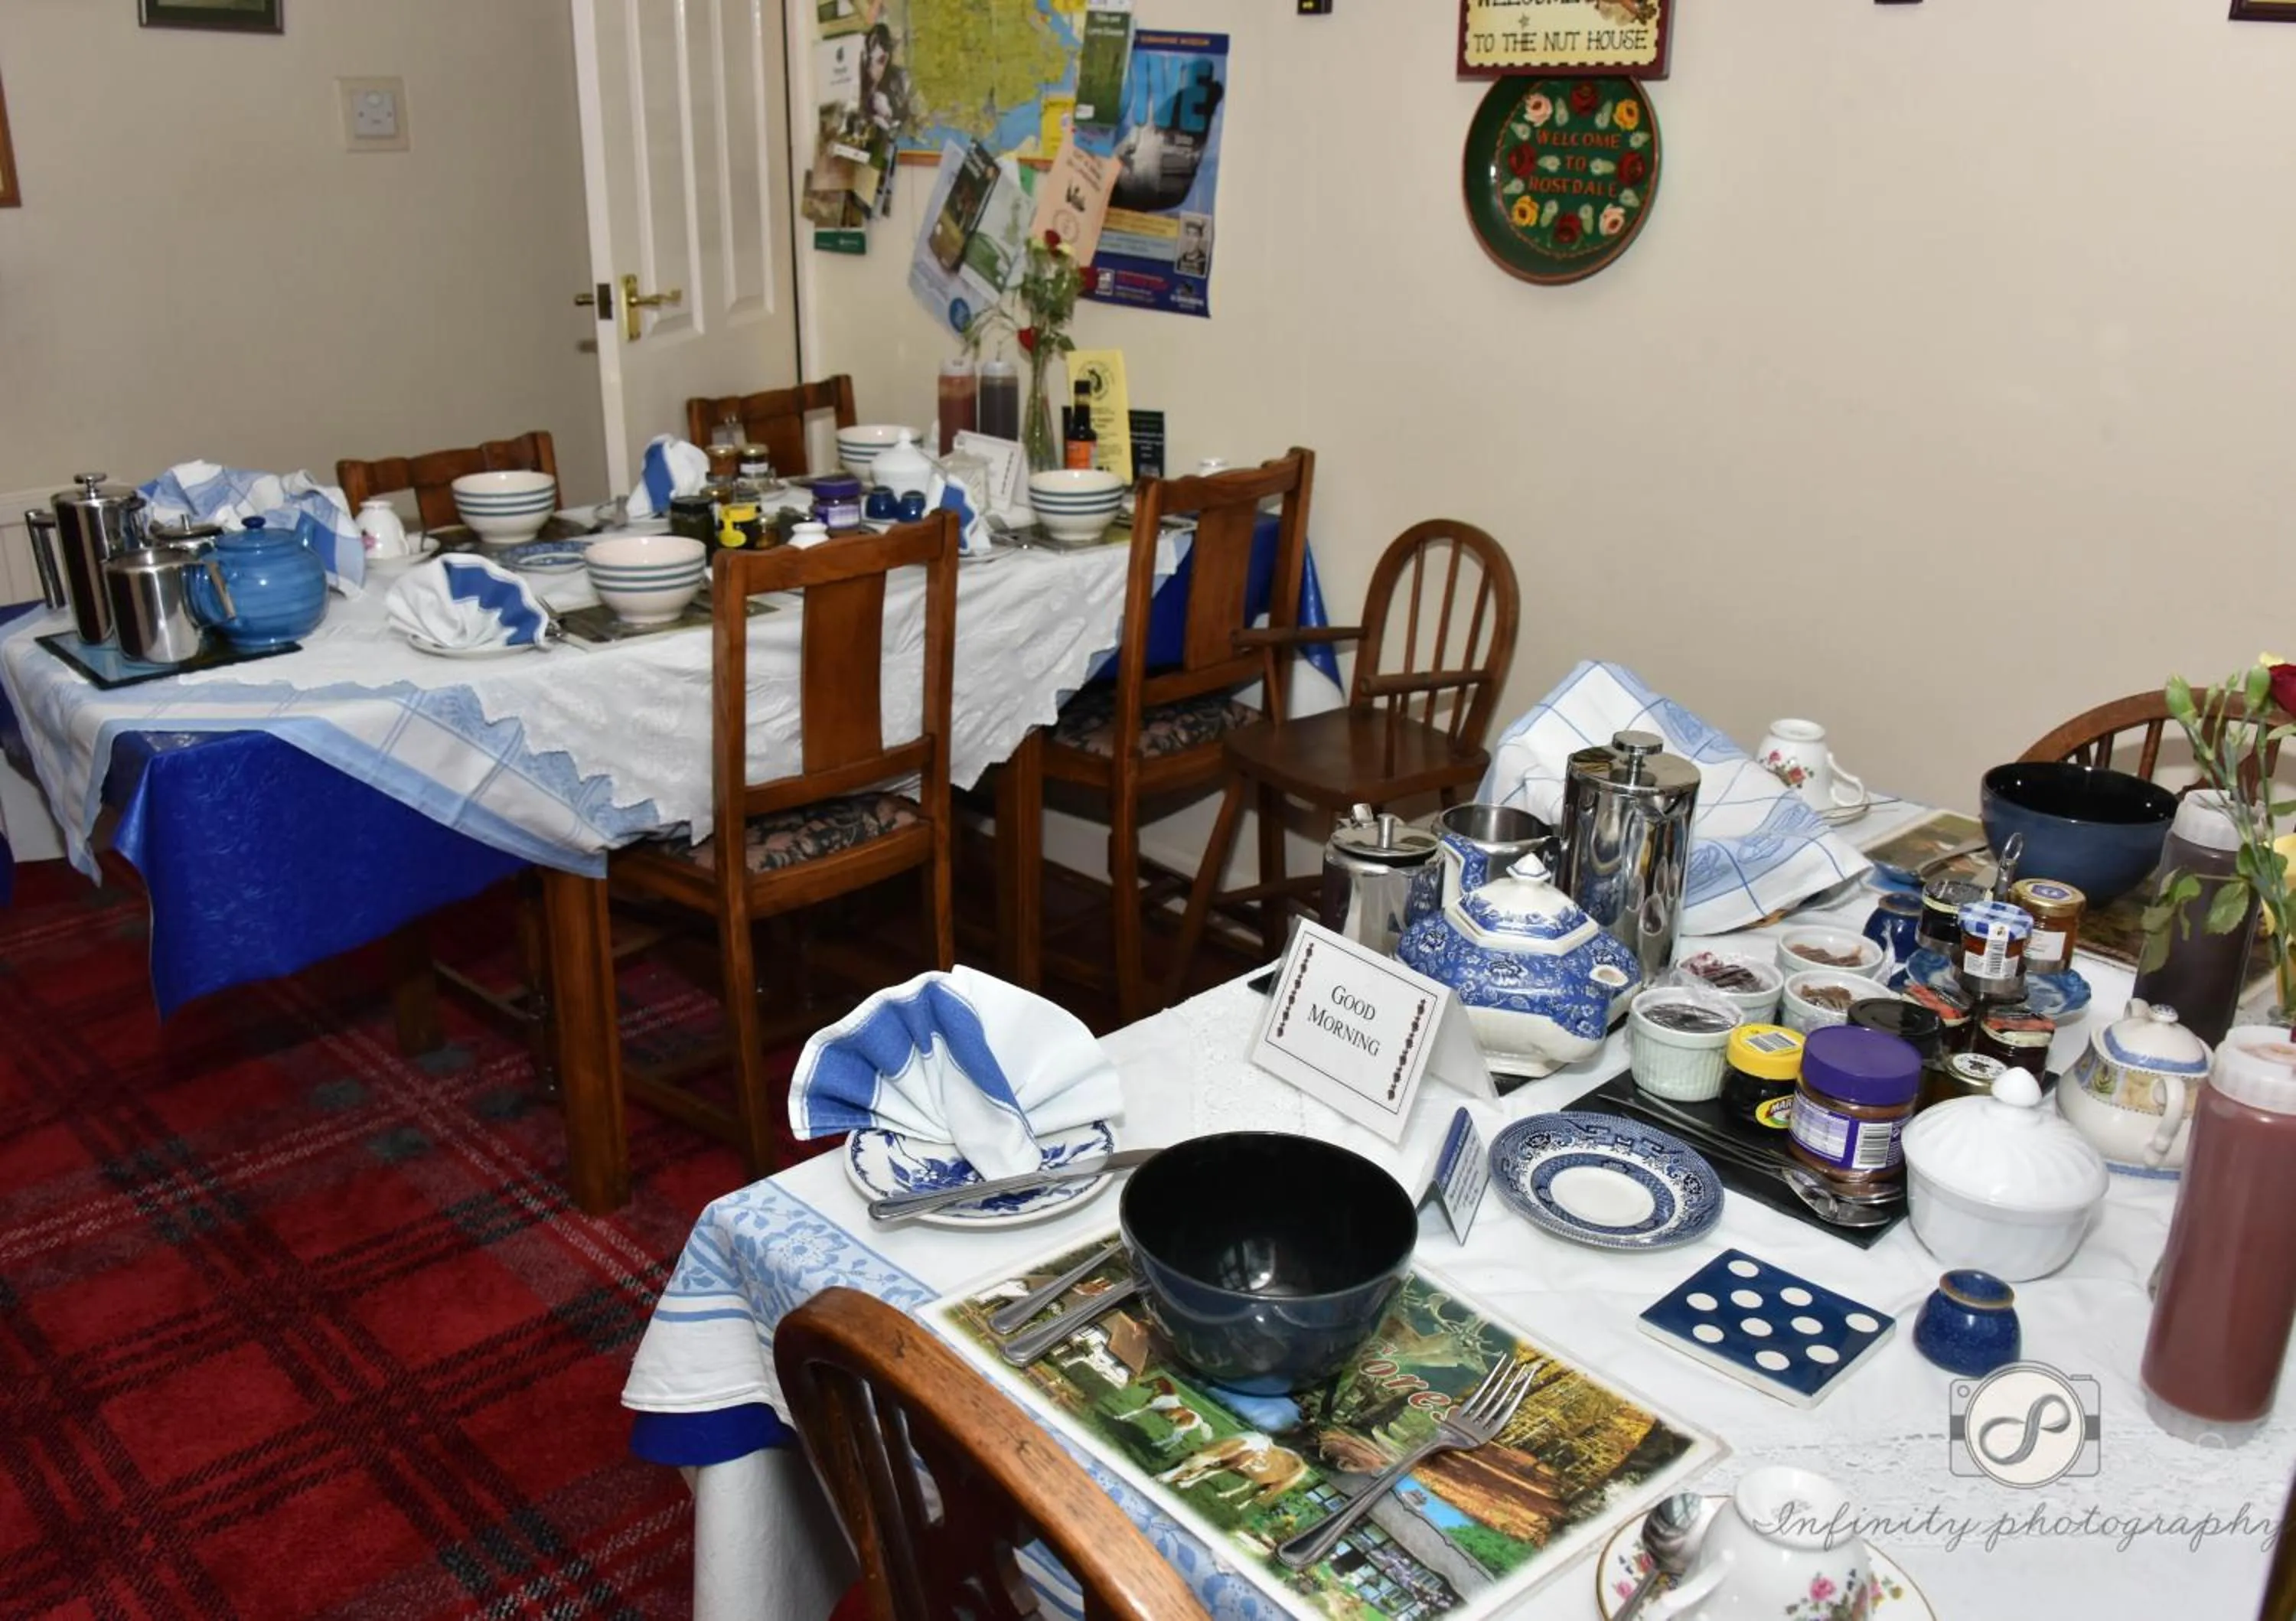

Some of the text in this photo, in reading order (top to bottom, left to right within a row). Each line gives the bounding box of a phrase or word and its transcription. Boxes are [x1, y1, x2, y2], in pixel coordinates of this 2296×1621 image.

[1474, 29, 1649, 53] TO THE NUT HOUSE
[1537, 129, 1621, 148] WELCOME
[1566, 155, 1587, 173] TO
[1529, 176, 1617, 198] ROSEDALE
[1331, 985, 1376, 1020] GOOD
[1307, 1003, 1381, 1056] MORNING
